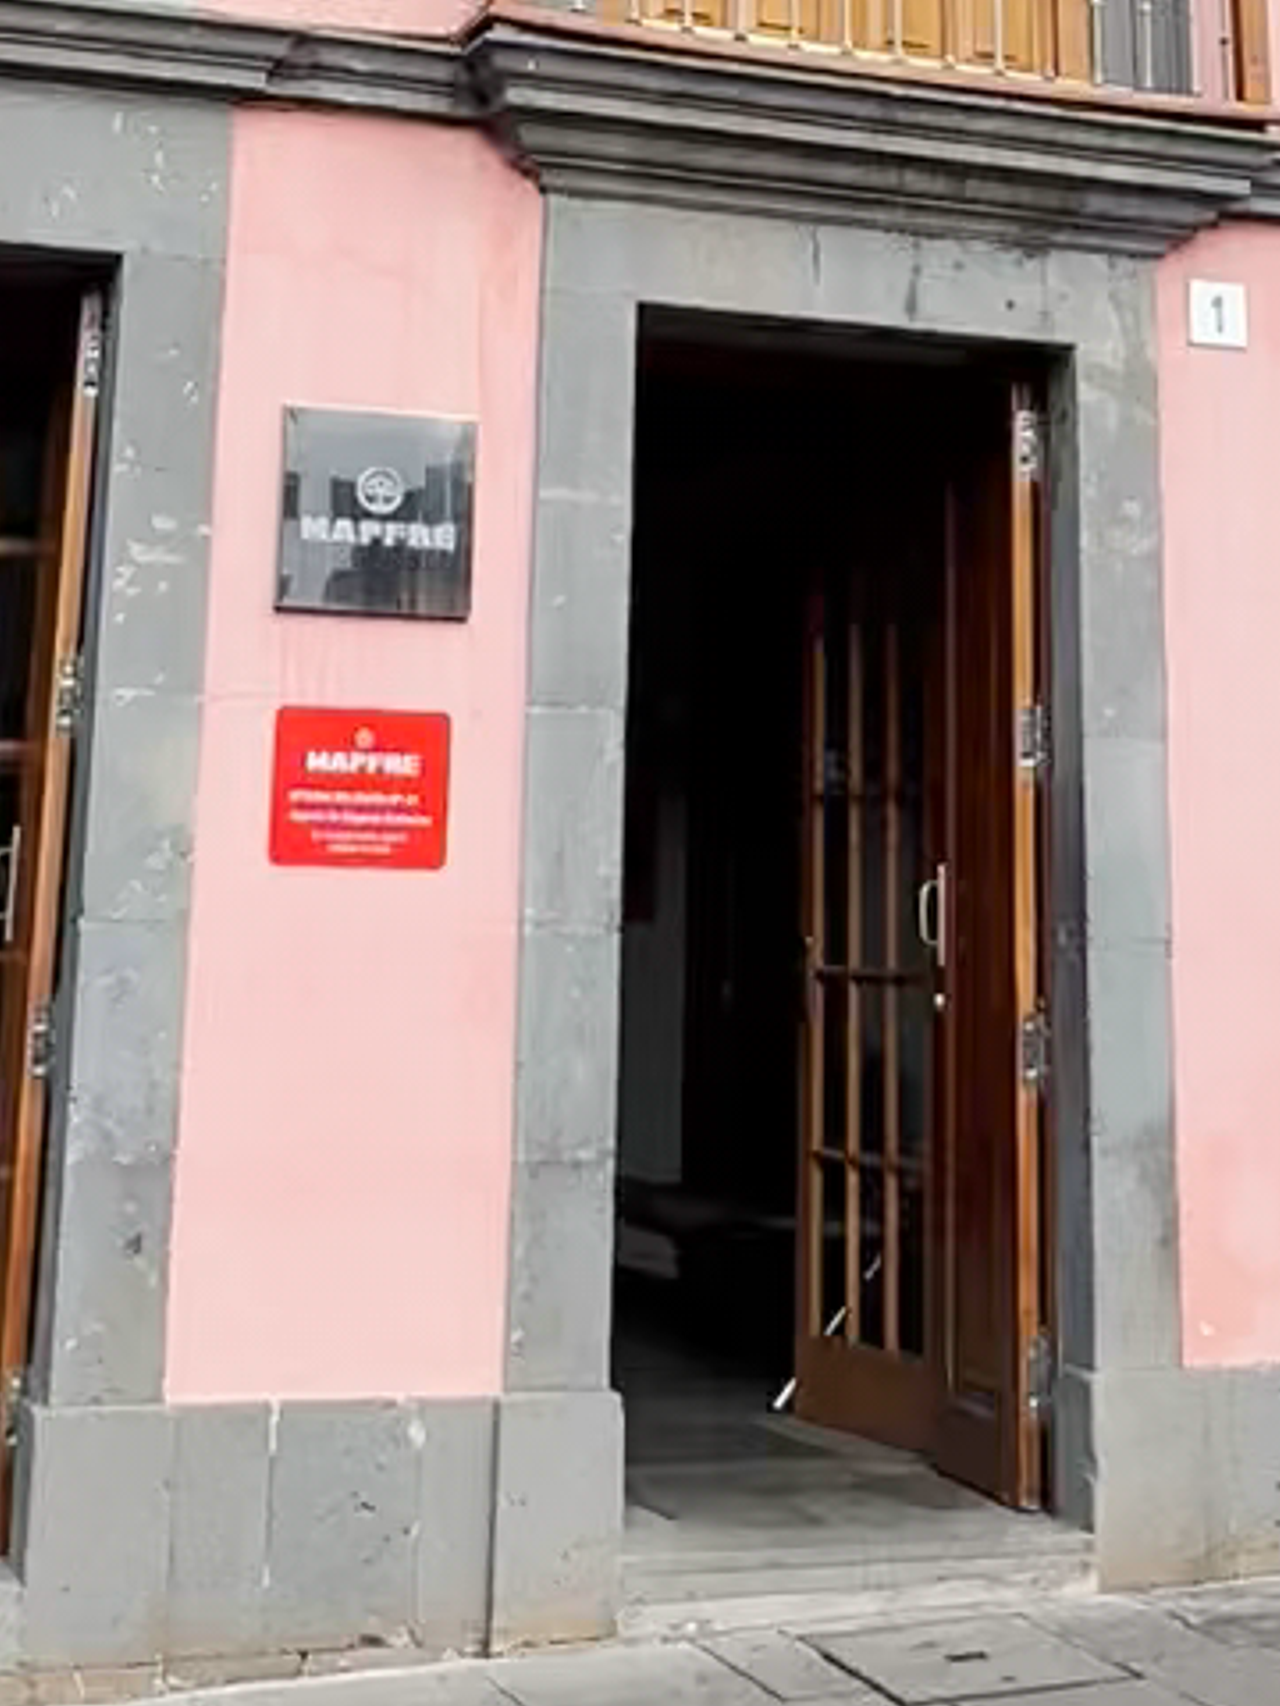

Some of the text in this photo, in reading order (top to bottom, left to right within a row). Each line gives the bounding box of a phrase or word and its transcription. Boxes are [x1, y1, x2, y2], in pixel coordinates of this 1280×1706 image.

[1210, 294, 1223, 334] 1
[300, 513, 455, 553] MAPFRE
[306, 750, 422, 779] MAPFRE
